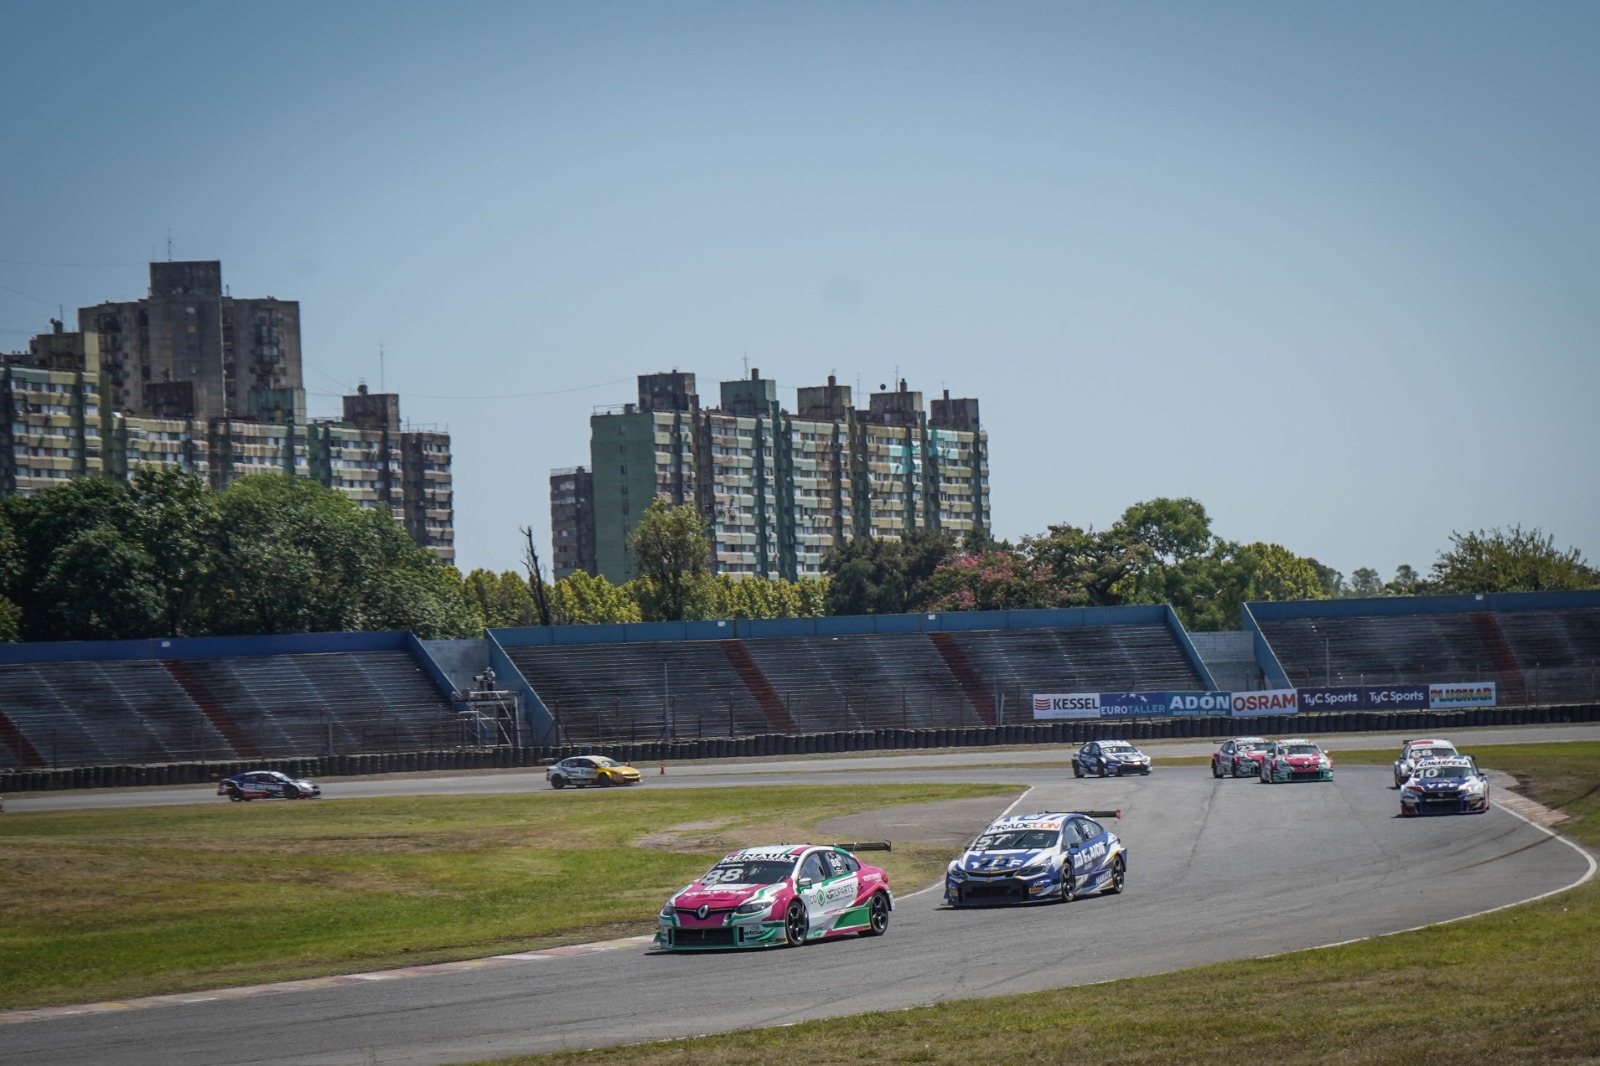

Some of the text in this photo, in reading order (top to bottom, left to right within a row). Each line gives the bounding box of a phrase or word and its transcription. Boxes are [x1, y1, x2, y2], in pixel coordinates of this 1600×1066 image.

[1169, 692, 1230, 710] ADÓN
[1232, 693, 1296, 712] OSRAM
[1304, 692, 1358, 706] TyC Sports
[1369, 690, 1424, 703] TyC Sports
[1053, 698, 1099, 710] KESSEL
[1101, 704, 1165, 715] EUROTALLER
[1415, 768, 1438, 778] 10
[975, 833, 1011, 848] 57
[721, 853, 800, 863] RENAULT
[702, 868, 743, 885] 88
